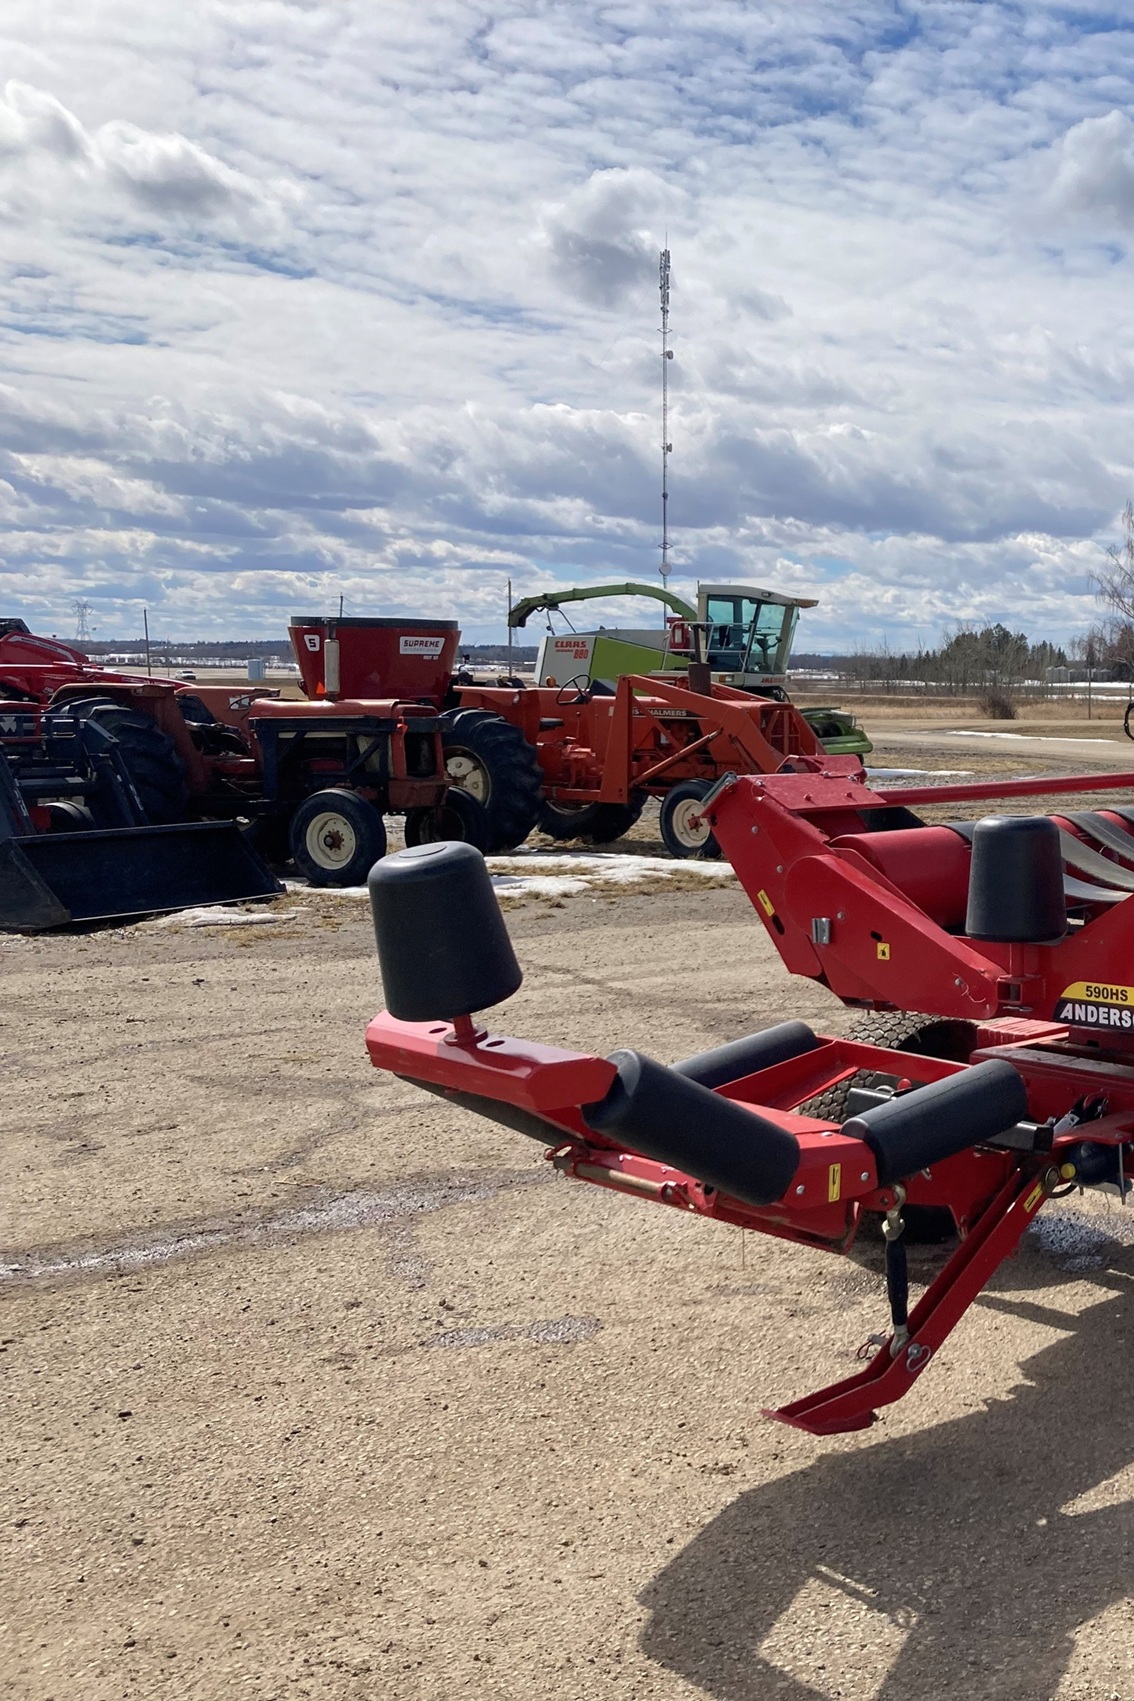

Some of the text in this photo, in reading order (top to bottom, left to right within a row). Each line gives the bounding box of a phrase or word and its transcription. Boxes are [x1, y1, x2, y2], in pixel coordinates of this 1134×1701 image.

[403, 639, 440, 648] SUPREME
[554, 640, 587, 648] CLAAS
[1085, 984, 1129, 1002] 590HS
